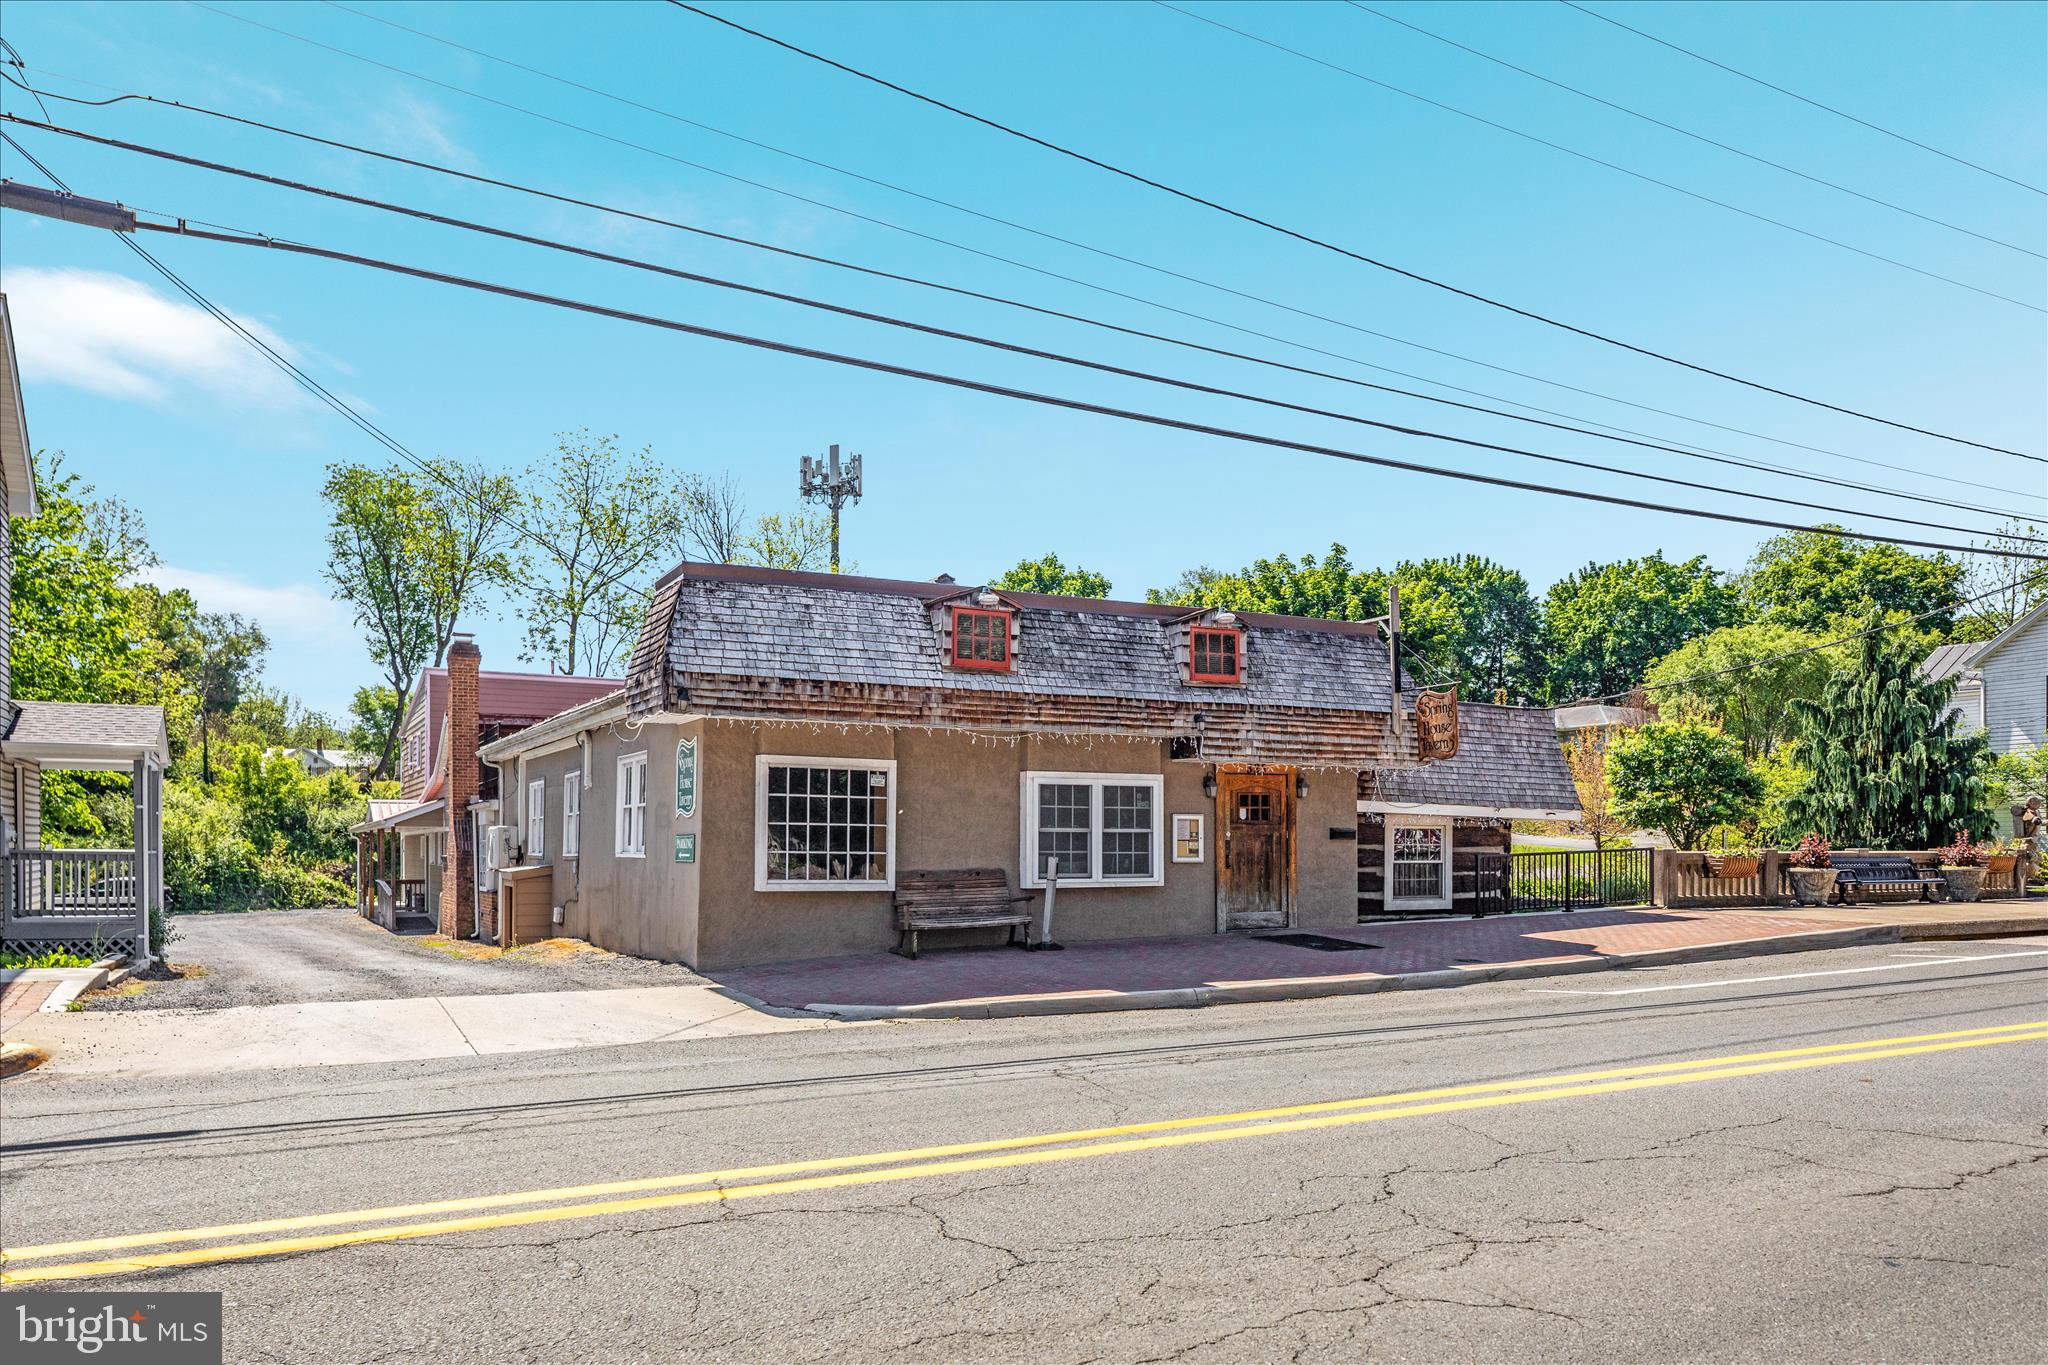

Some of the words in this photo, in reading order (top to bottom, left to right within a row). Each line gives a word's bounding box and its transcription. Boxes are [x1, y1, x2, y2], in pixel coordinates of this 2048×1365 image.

[1421, 701, 1454, 718] Spring
[1423, 721, 1452, 735] House
[1421, 737, 1454, 752] Tavern
[680, 775, 692, 789] House
[676, 838, 693, 849] PARKING
